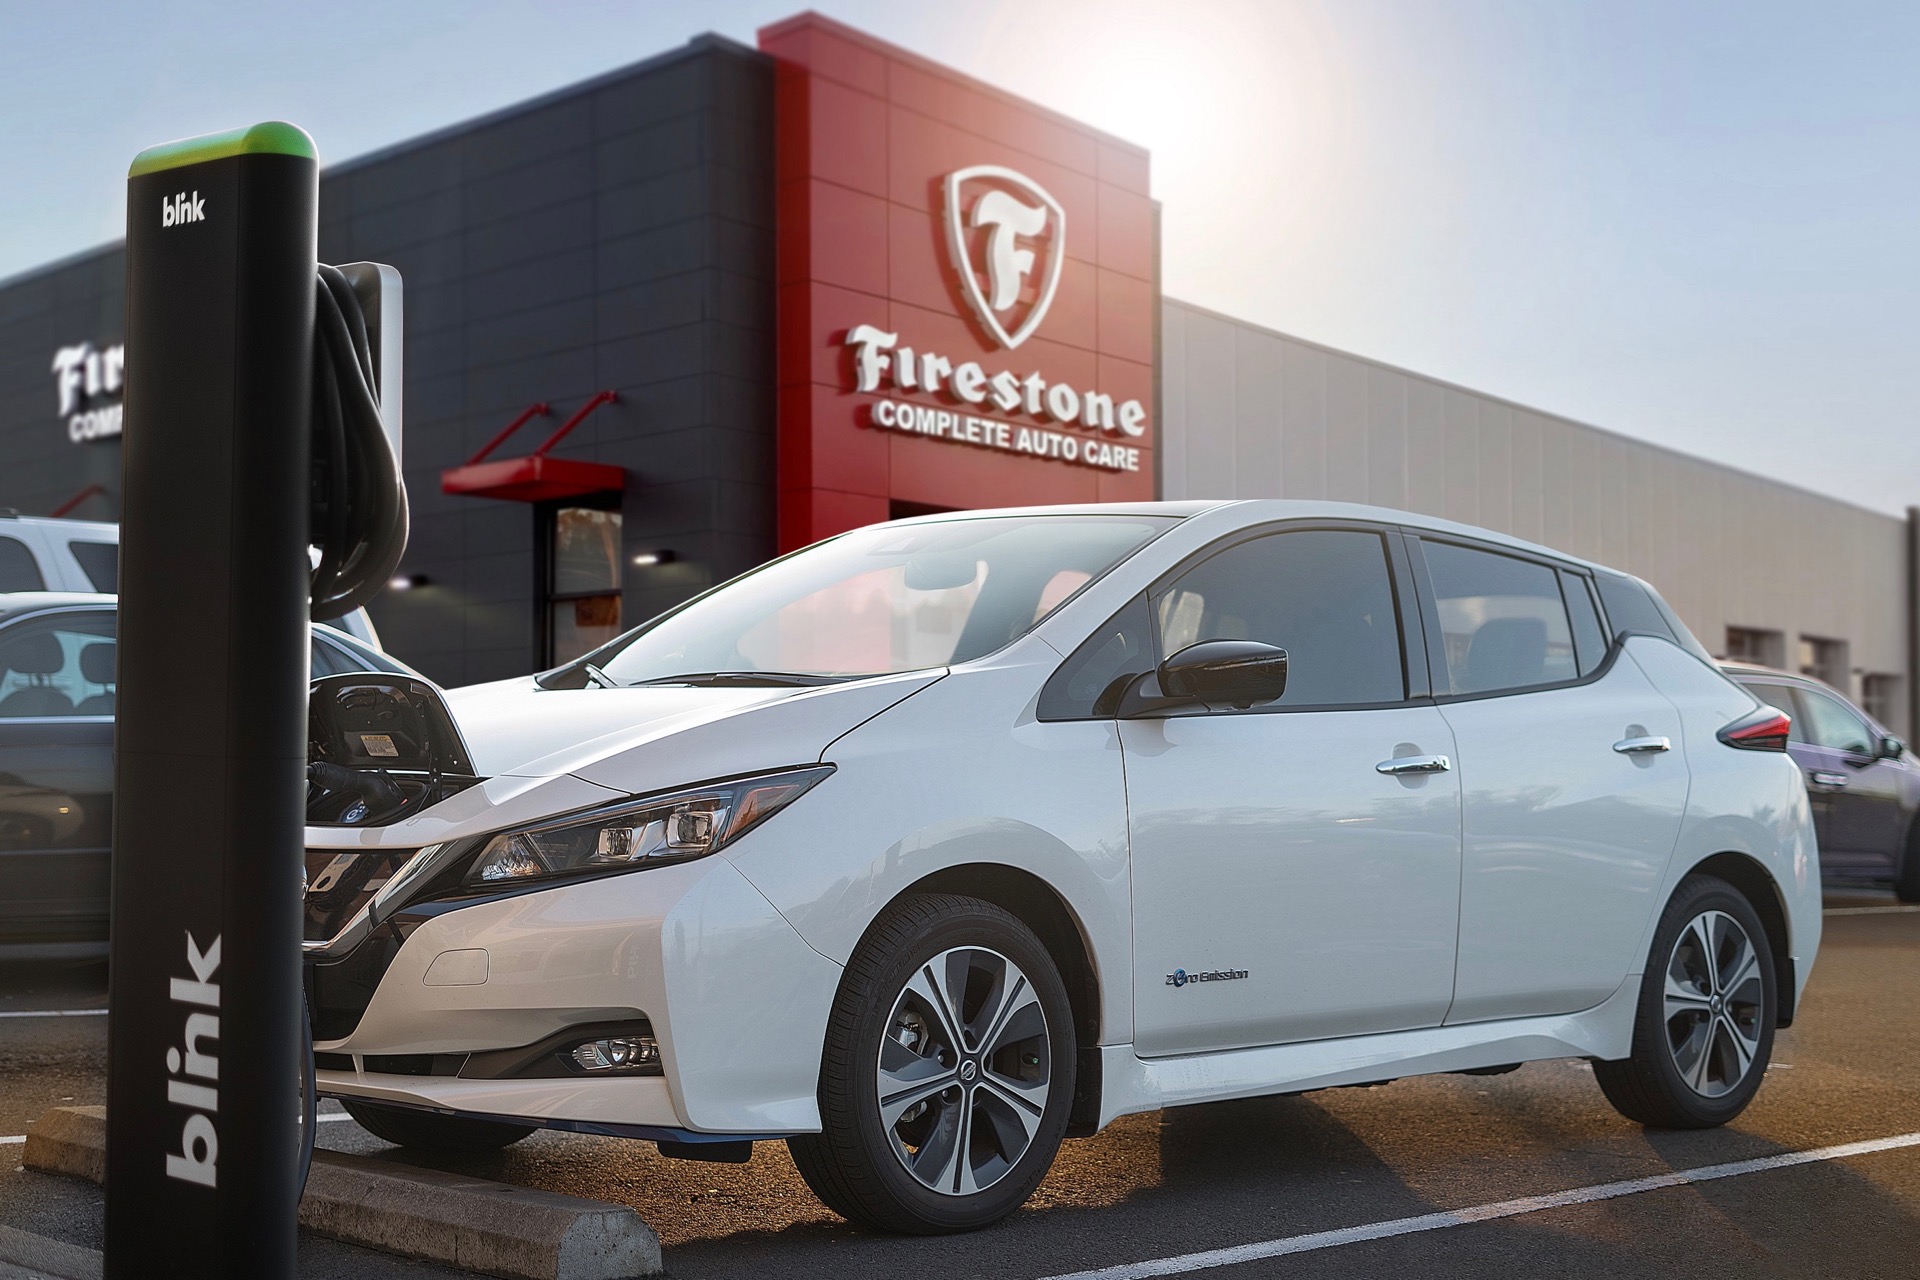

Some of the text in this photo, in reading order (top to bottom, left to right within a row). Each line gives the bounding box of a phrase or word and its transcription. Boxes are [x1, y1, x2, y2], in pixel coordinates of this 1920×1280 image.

[162, 190, 206, 228] blink
[846, 324, 1146, 437] Firestone
[874, 399, 1139, 471] COMPLETE AUTO CARE
[166, 930, 222, 1188] blink
